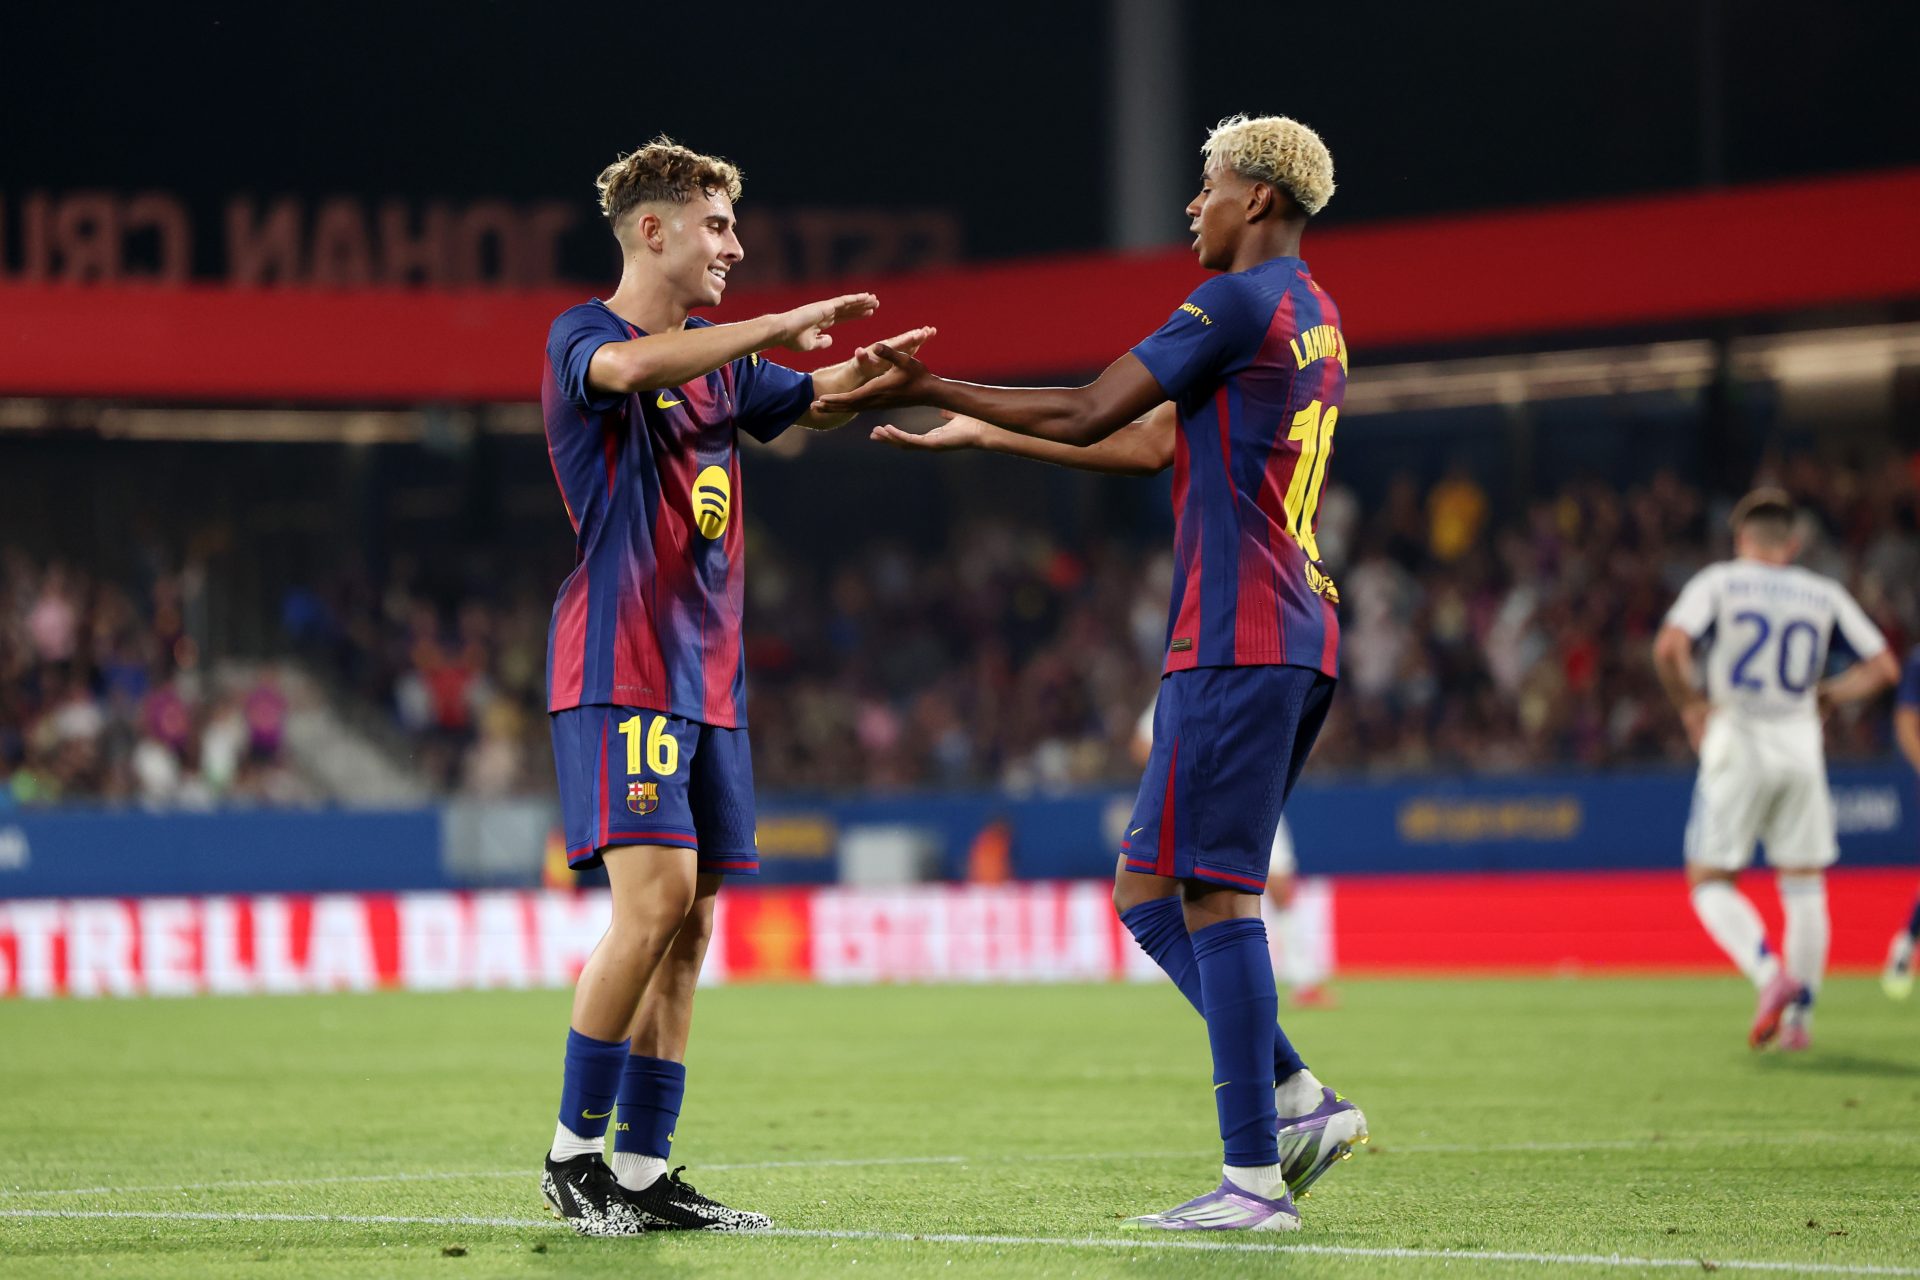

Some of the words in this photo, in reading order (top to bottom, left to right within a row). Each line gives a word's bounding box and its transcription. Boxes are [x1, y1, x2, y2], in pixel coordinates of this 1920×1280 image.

[1289, 324, 1337, 371] LAMINE
[1730, 609, 1819, 695] 20
[618, 715, 679, 776] 16
